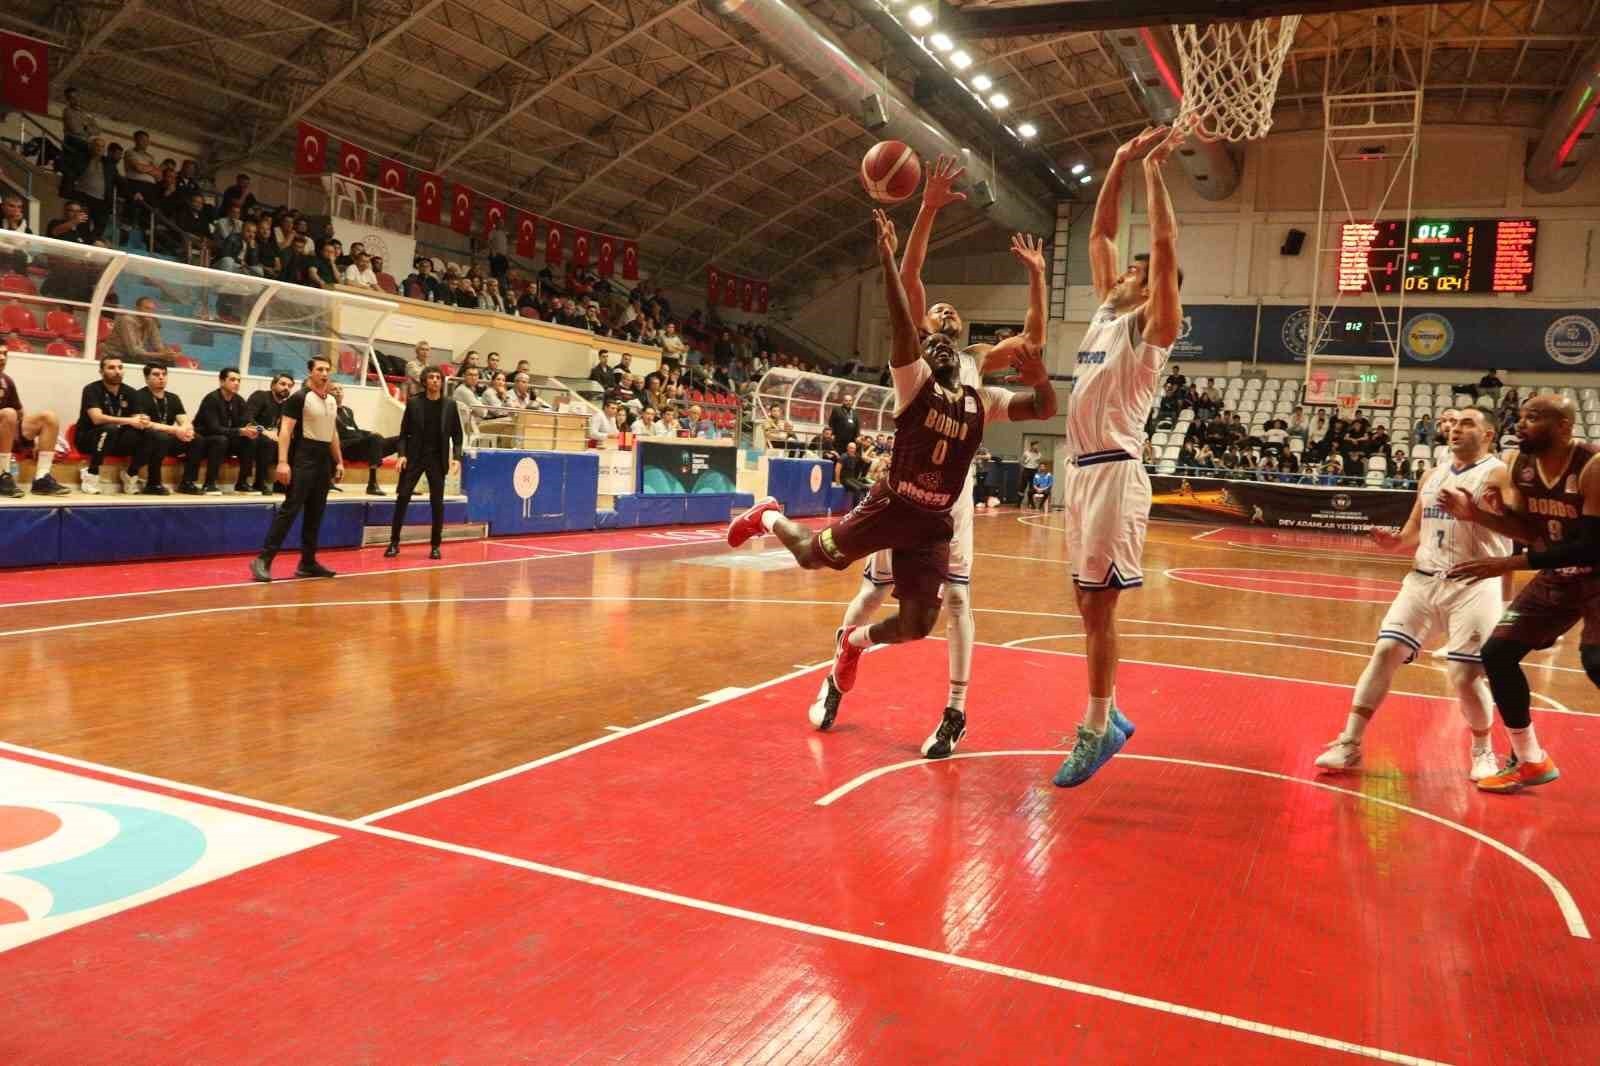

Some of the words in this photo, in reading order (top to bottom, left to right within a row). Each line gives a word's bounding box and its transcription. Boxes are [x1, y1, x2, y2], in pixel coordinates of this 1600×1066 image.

[1345, 322, 1362, 331] 012
[924, 408, 968, 440] BORDO
[932, 440, 948, 464] 0
[1528, 497, 1577, 519] BORDO
[1279, 518, 1296, 527] DEV
[1436, 530, 1444, 548] 7
